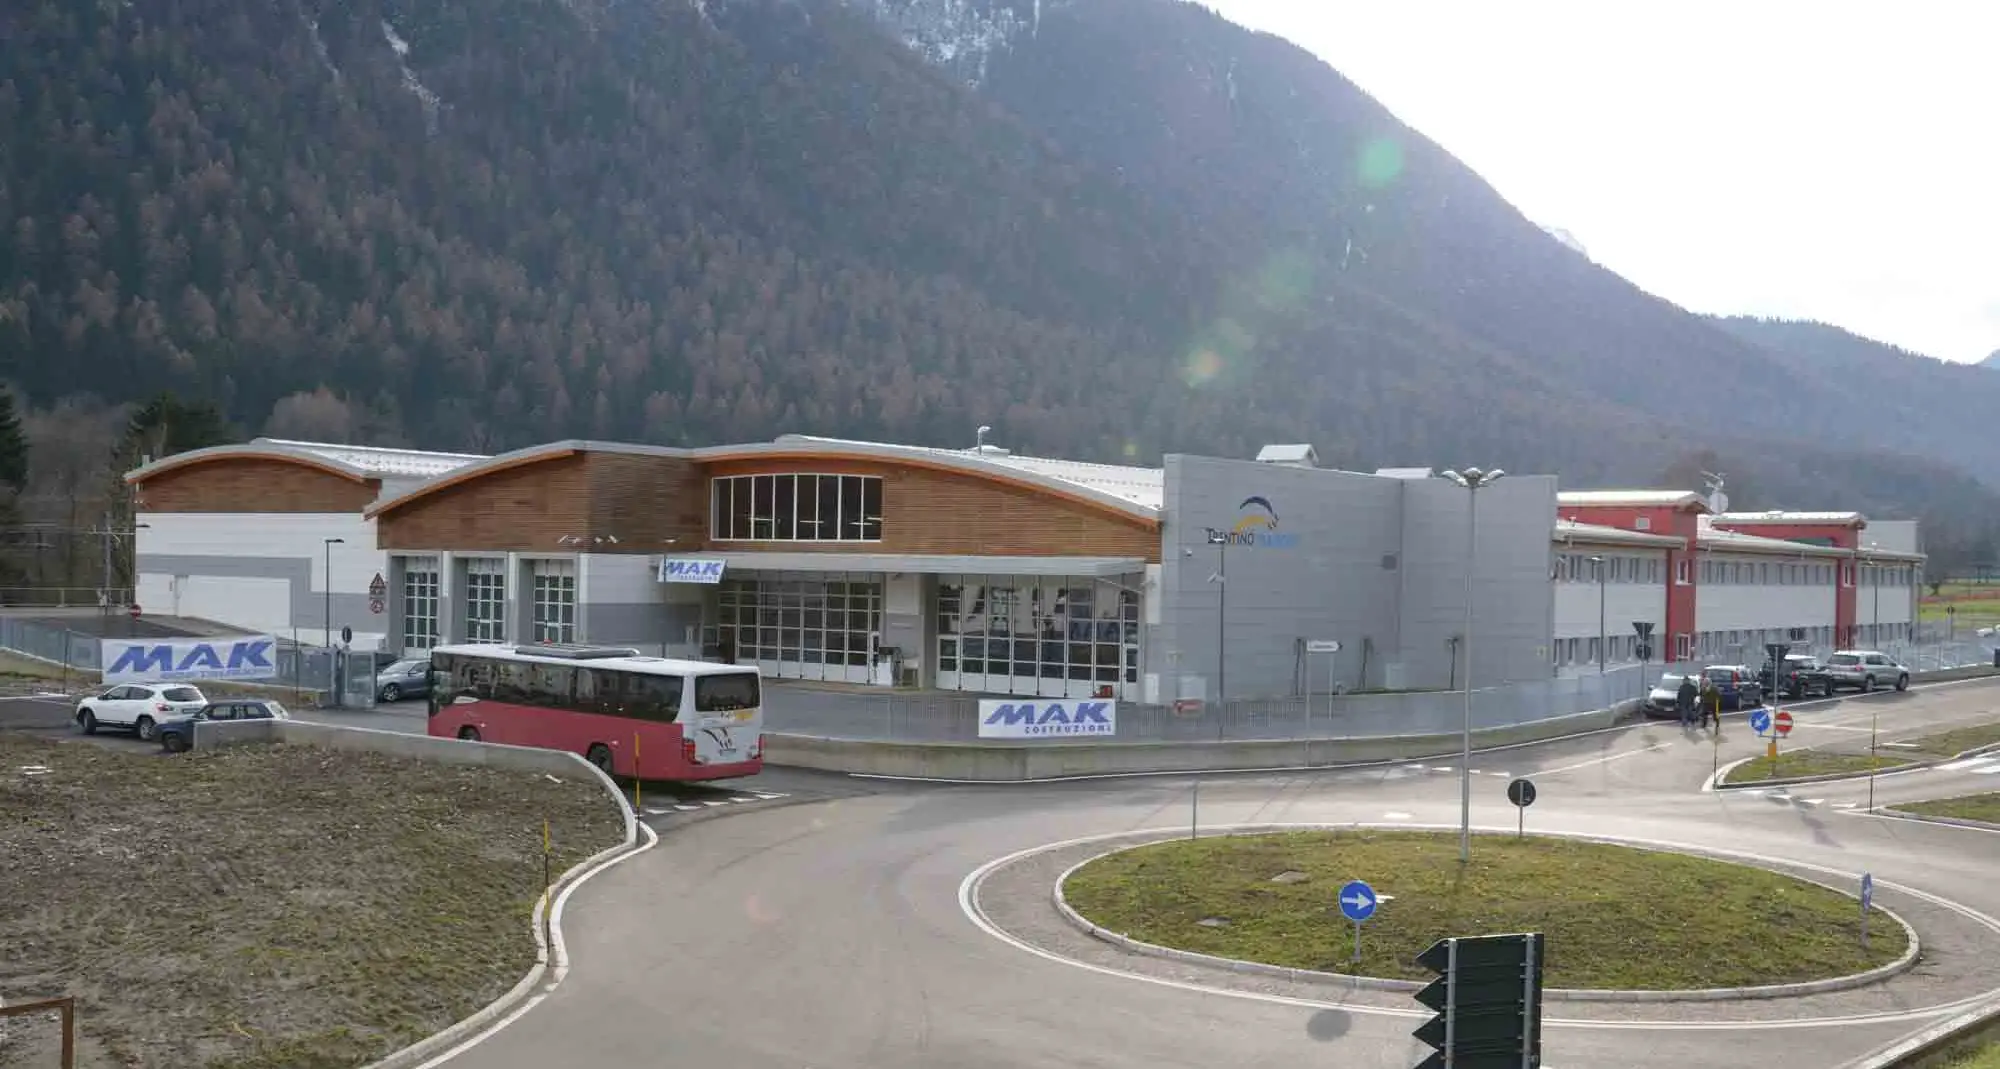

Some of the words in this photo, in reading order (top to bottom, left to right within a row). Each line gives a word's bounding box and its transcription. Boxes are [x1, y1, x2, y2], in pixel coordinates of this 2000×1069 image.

[666, 562, 720, 575] MAK
[107, 641, 273, 673] MAK
[984, 703, 1110, 725] MAK
[1025, 725, 1111, 734] COSTRUZIONI
